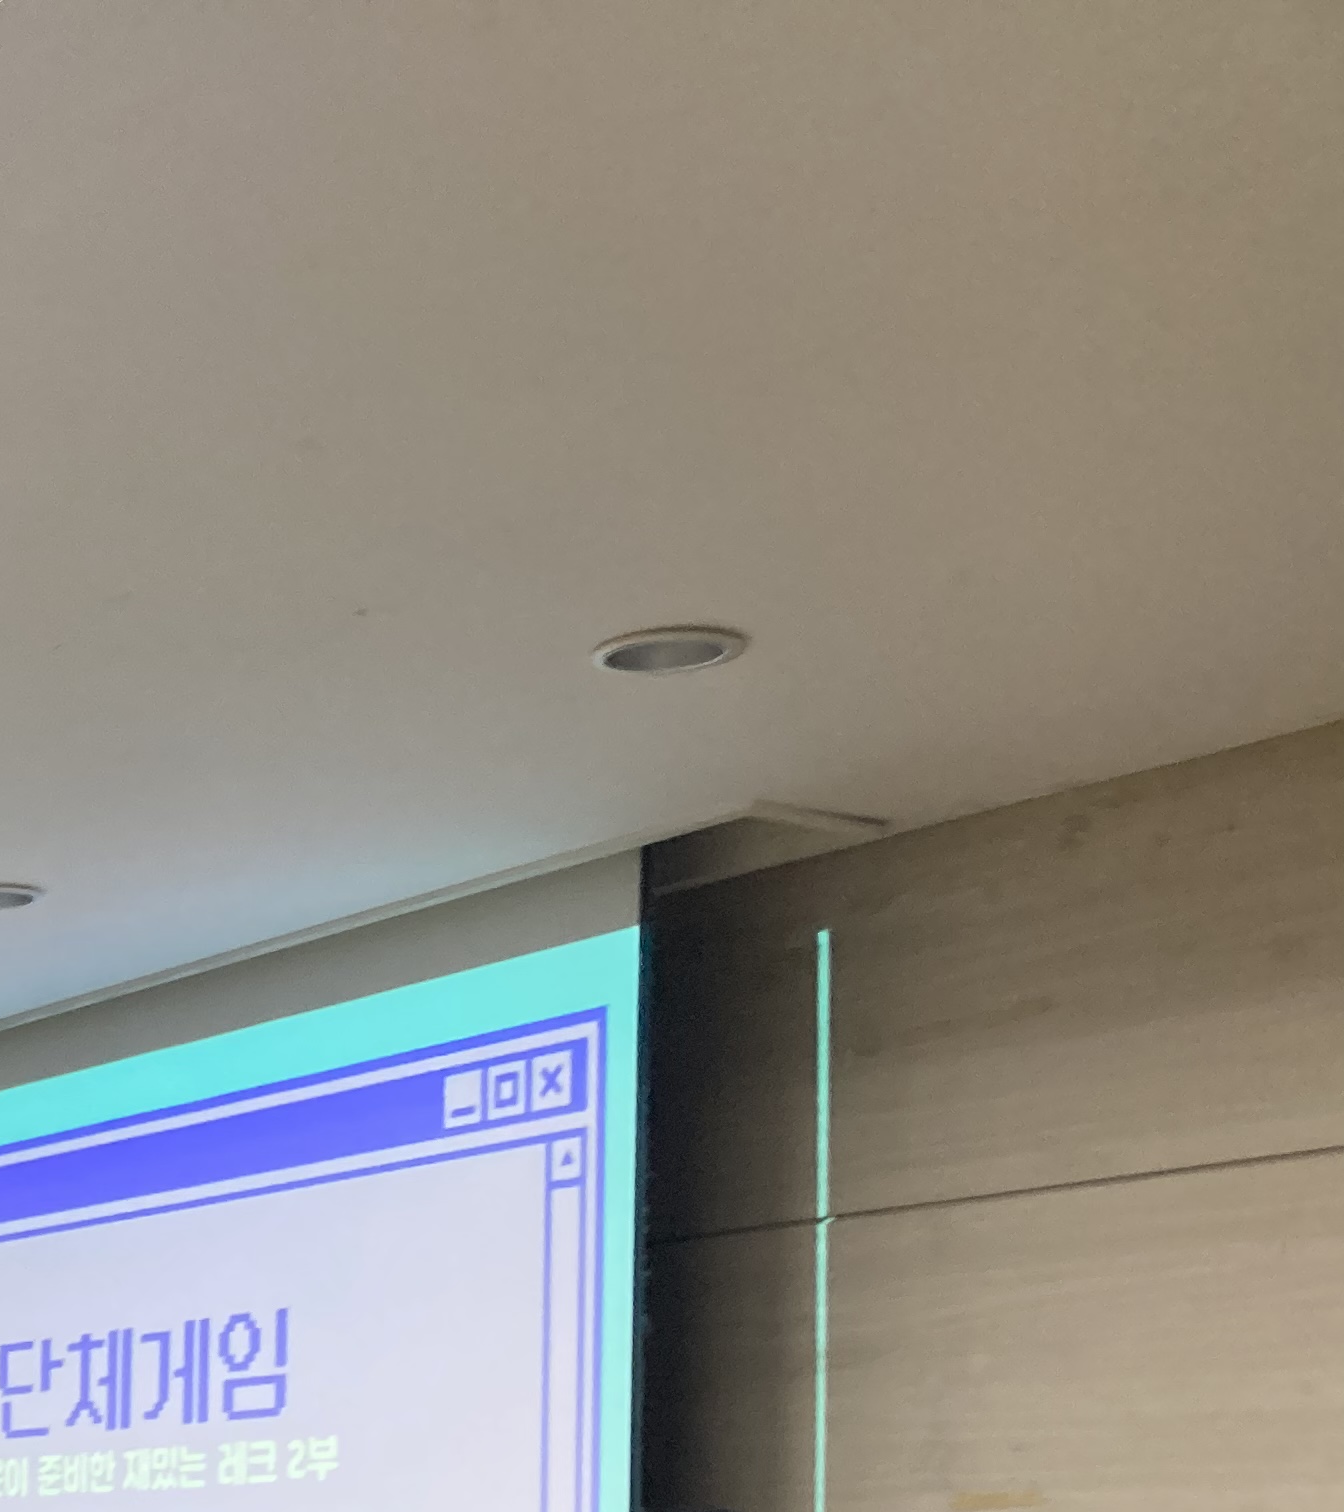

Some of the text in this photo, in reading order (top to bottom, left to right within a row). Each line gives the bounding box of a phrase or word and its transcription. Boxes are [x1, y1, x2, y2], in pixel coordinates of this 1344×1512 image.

[38, 1450, 115, 1497] 준비한
[122, 1445, 206, 1491] 재밌는
[217, 1439, 278, 1485] 레크
[287, 1434, 340, 1481] 2부
